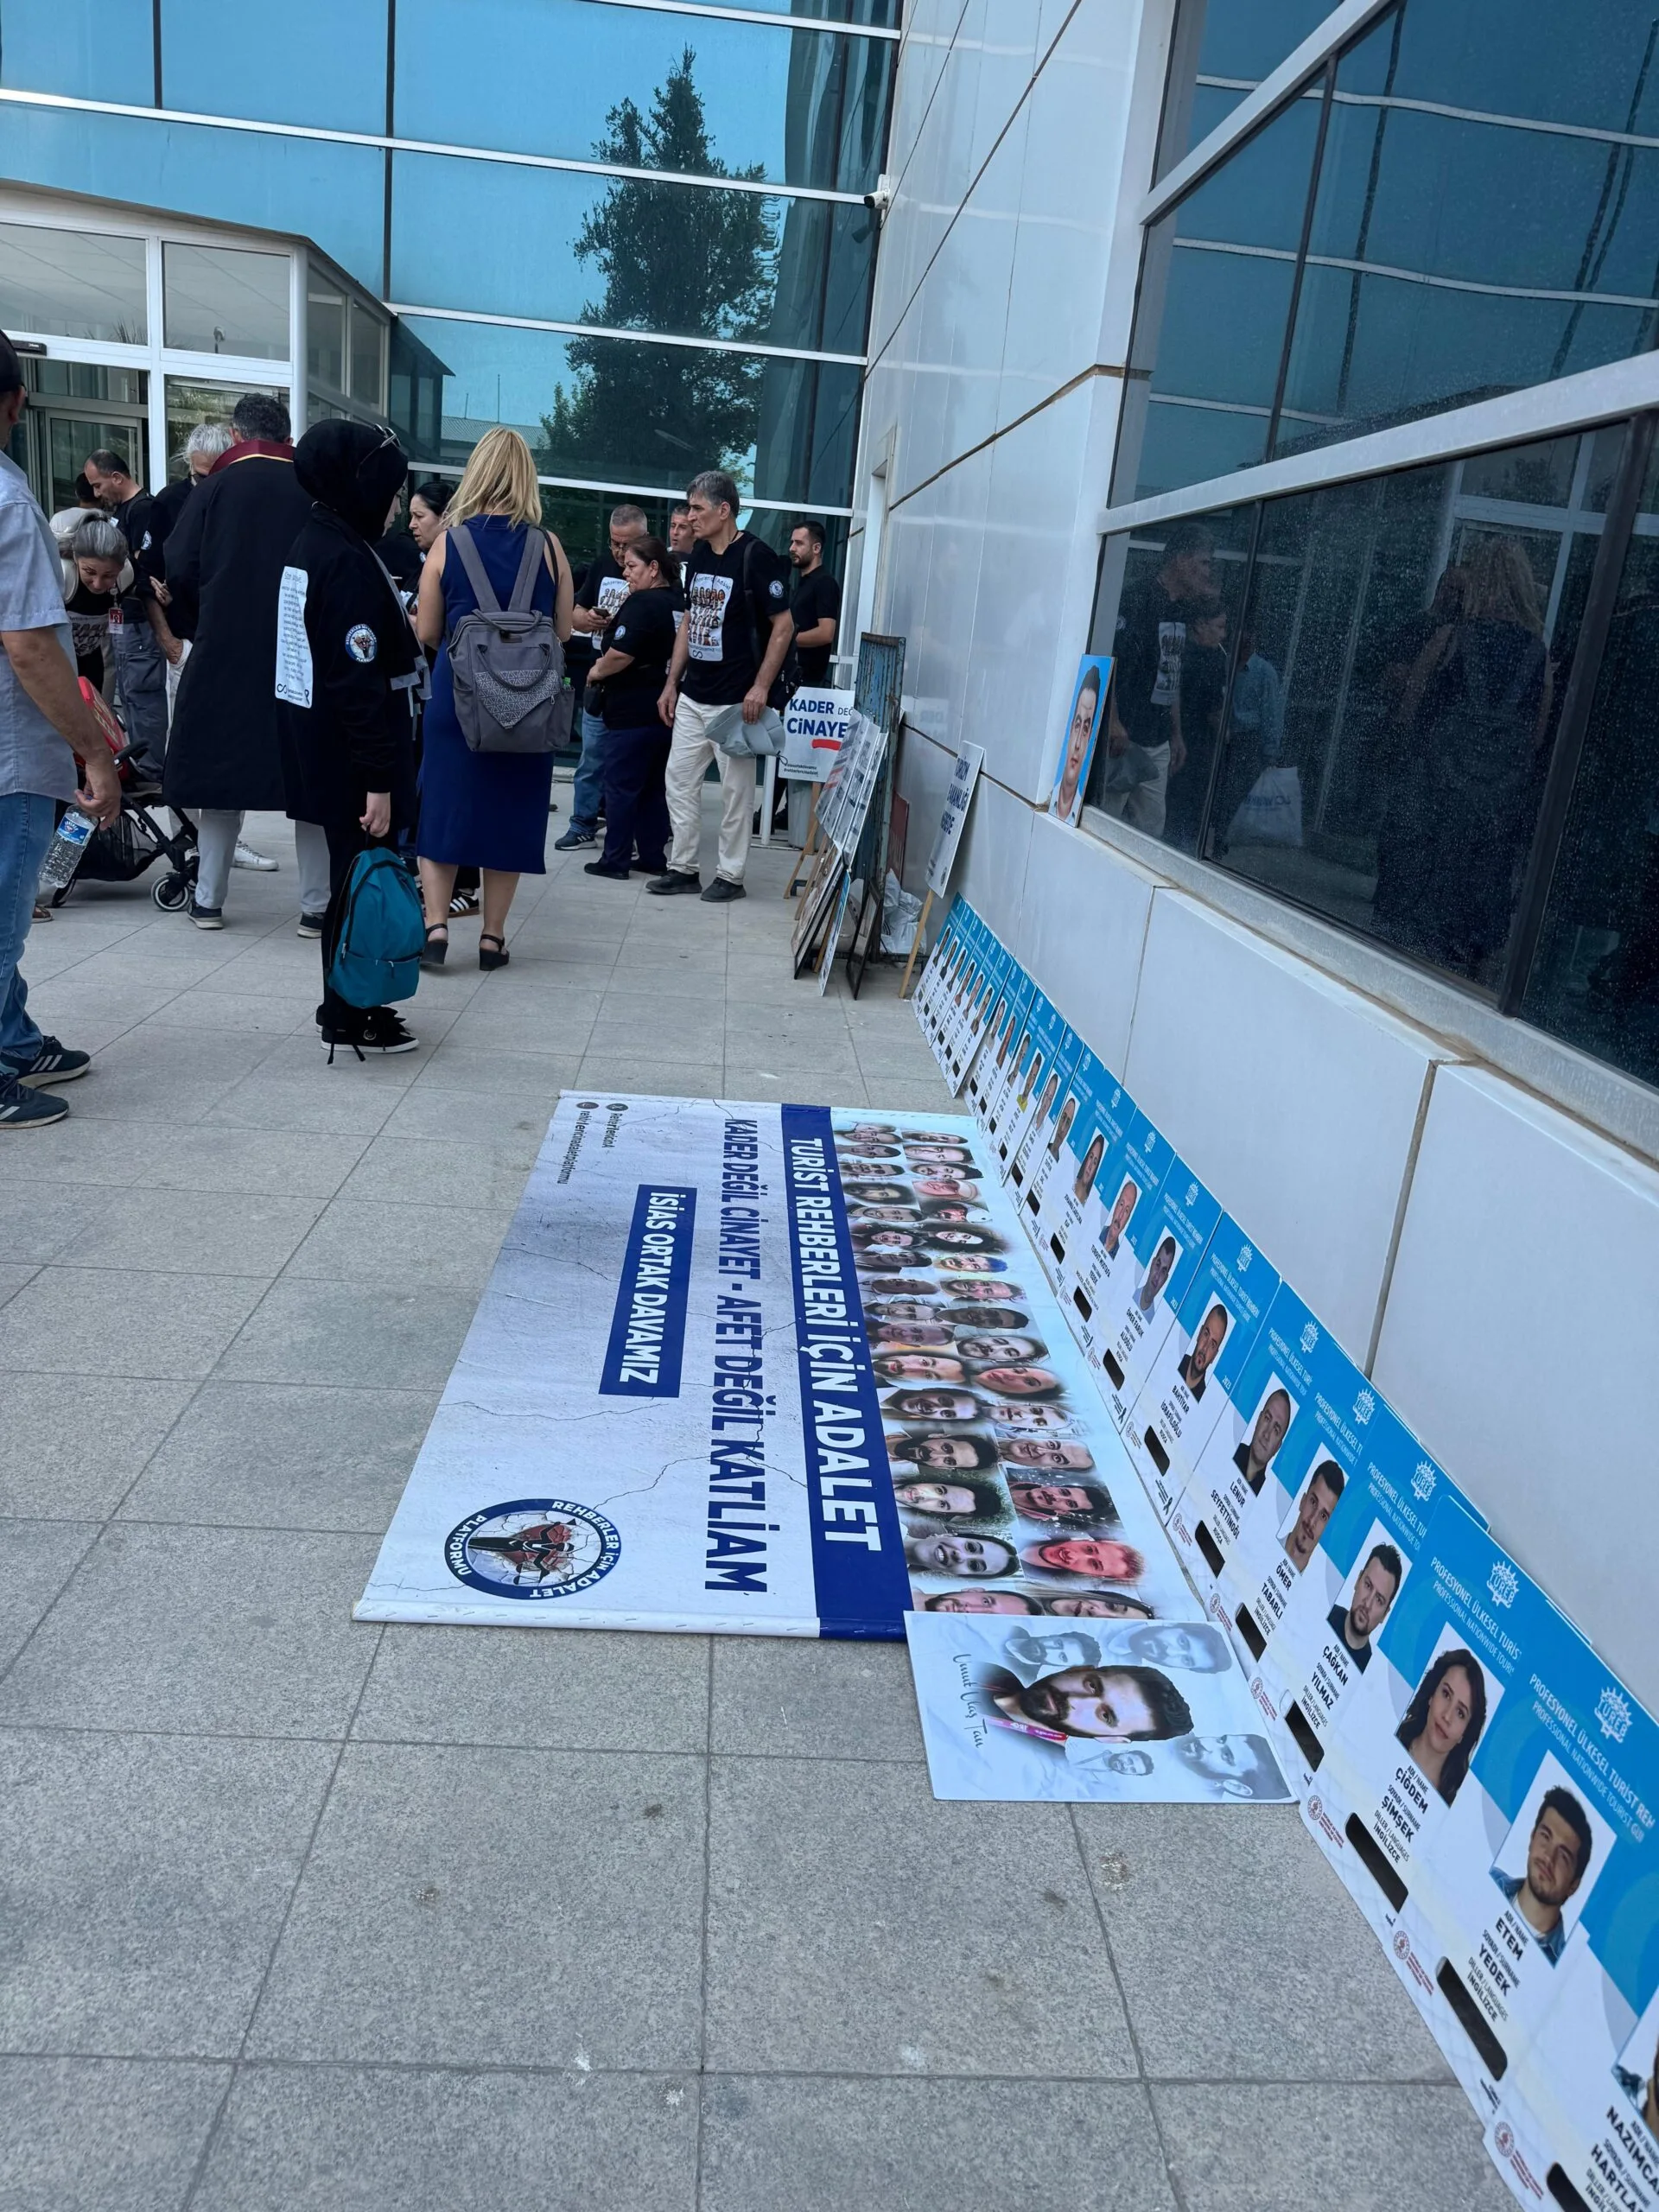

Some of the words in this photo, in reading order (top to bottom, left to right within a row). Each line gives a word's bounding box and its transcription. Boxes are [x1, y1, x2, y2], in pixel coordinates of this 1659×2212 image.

[789, 698, 835, 715] KADER
[723, 1118, 759, 1159] KADER
[721, 1164, 768, 1203] DEĞİL
[790, 1138, 835, 1192] TURİST
[645, 1192, 686, 1230] İSİAS
[635, 1233, 676, 1290] ORTAK
[718, 1206, 768, 1280] CİNAYET
[795, 1195, 860, 1327] REHBERLERİ
[620, 1293, 668, 1384] DAVAMIZ
[715, 1294, 762, 1350] AFET
[799, 1333, 866, 1392] İÇİN
[711, 1355, 777, 1431] DEĞİL
[1314, 1392, 1341, 1429] PROFESYONEL
[813, 1400, 882, 1552] ADALET
[1230, 1481, 1246, 1508] LENUR
[1367, 1461, 1399, 1504] PROFESYONEL
[1396, 1496, 1418, 1529] ÜLKESEL
[551, 1500, 619, 1549] REHBERLER
[704, 1439, 780, 1592] KATLİAM
[1368, 1482, 1394, 1517] PROFESSIONAL
[1391, 1512, 1415, 1545] NATIONWIDE
[449, 1515, 488, 1576] PLATFORMU
[529, 1572, 601, 1598] ADALET
[1262, 1582, 1283, 1620] TABARLI
[1275, 1561, 1292, 1592] ÖMER
[1430, 1555, 1473, 1609] PROFESYONEL
[1471, 1599, 1500, 1639] ÜLKESEL
[1498, 1630, 1522, 1661] TURİS
[1433, 1580, 1467, 1624] PROFESSIONAL
[1466, 1617, 1497, 1657] NATIONWIDE
[1311, 1671, 1334, 1710] YILMAZ
[1322, 1645, 1349, 1686] ÇAĞKAN
[1301, 1694, 1321, 1730] İNGİLİZCE
[1529, 1673, 1578, 1738] PROFESYONEL
[1577, 1730, 1610, 1777] ÜLKESEL
[1607, 1768, 1639, 1809] TURİST
[1531, 1700, 1573, 1754] PROFESSIONAL
[1570, 1747, 1606, 1798] NATIONWIDE
[1605, 1788, 1634, 1828] TOURIST
[1395, 1767, 1428, 1815] ÇİĞDEM
[1407, 1764, 1416, 1777] ADI
[1415, 1777, 1429, 1796] NAME
[1381, 1796, 1414, 1844] ŞİMŞEK
[1387, 1784, 1402, 1806] SOYADI
[1402, 1805, 1421, 1832] SURNAME
[1373, 1821, 1401, 1864] İNGİLİZCE
[1388, 1830, 1410, 1862] LANGUAGES
[1495, 1916, 1523, 1962] ETEM
[1514, 1925, 1529, 1947] NAME
[1478, 1942, 1511, 1997] YEDEK
[1467, 1971, 1498, 2023] İNGİLİZCE
[1605, 2105, 1659, 2196] NAZIMCA
[1591, 2143, 1644, 2212] HARTLA
